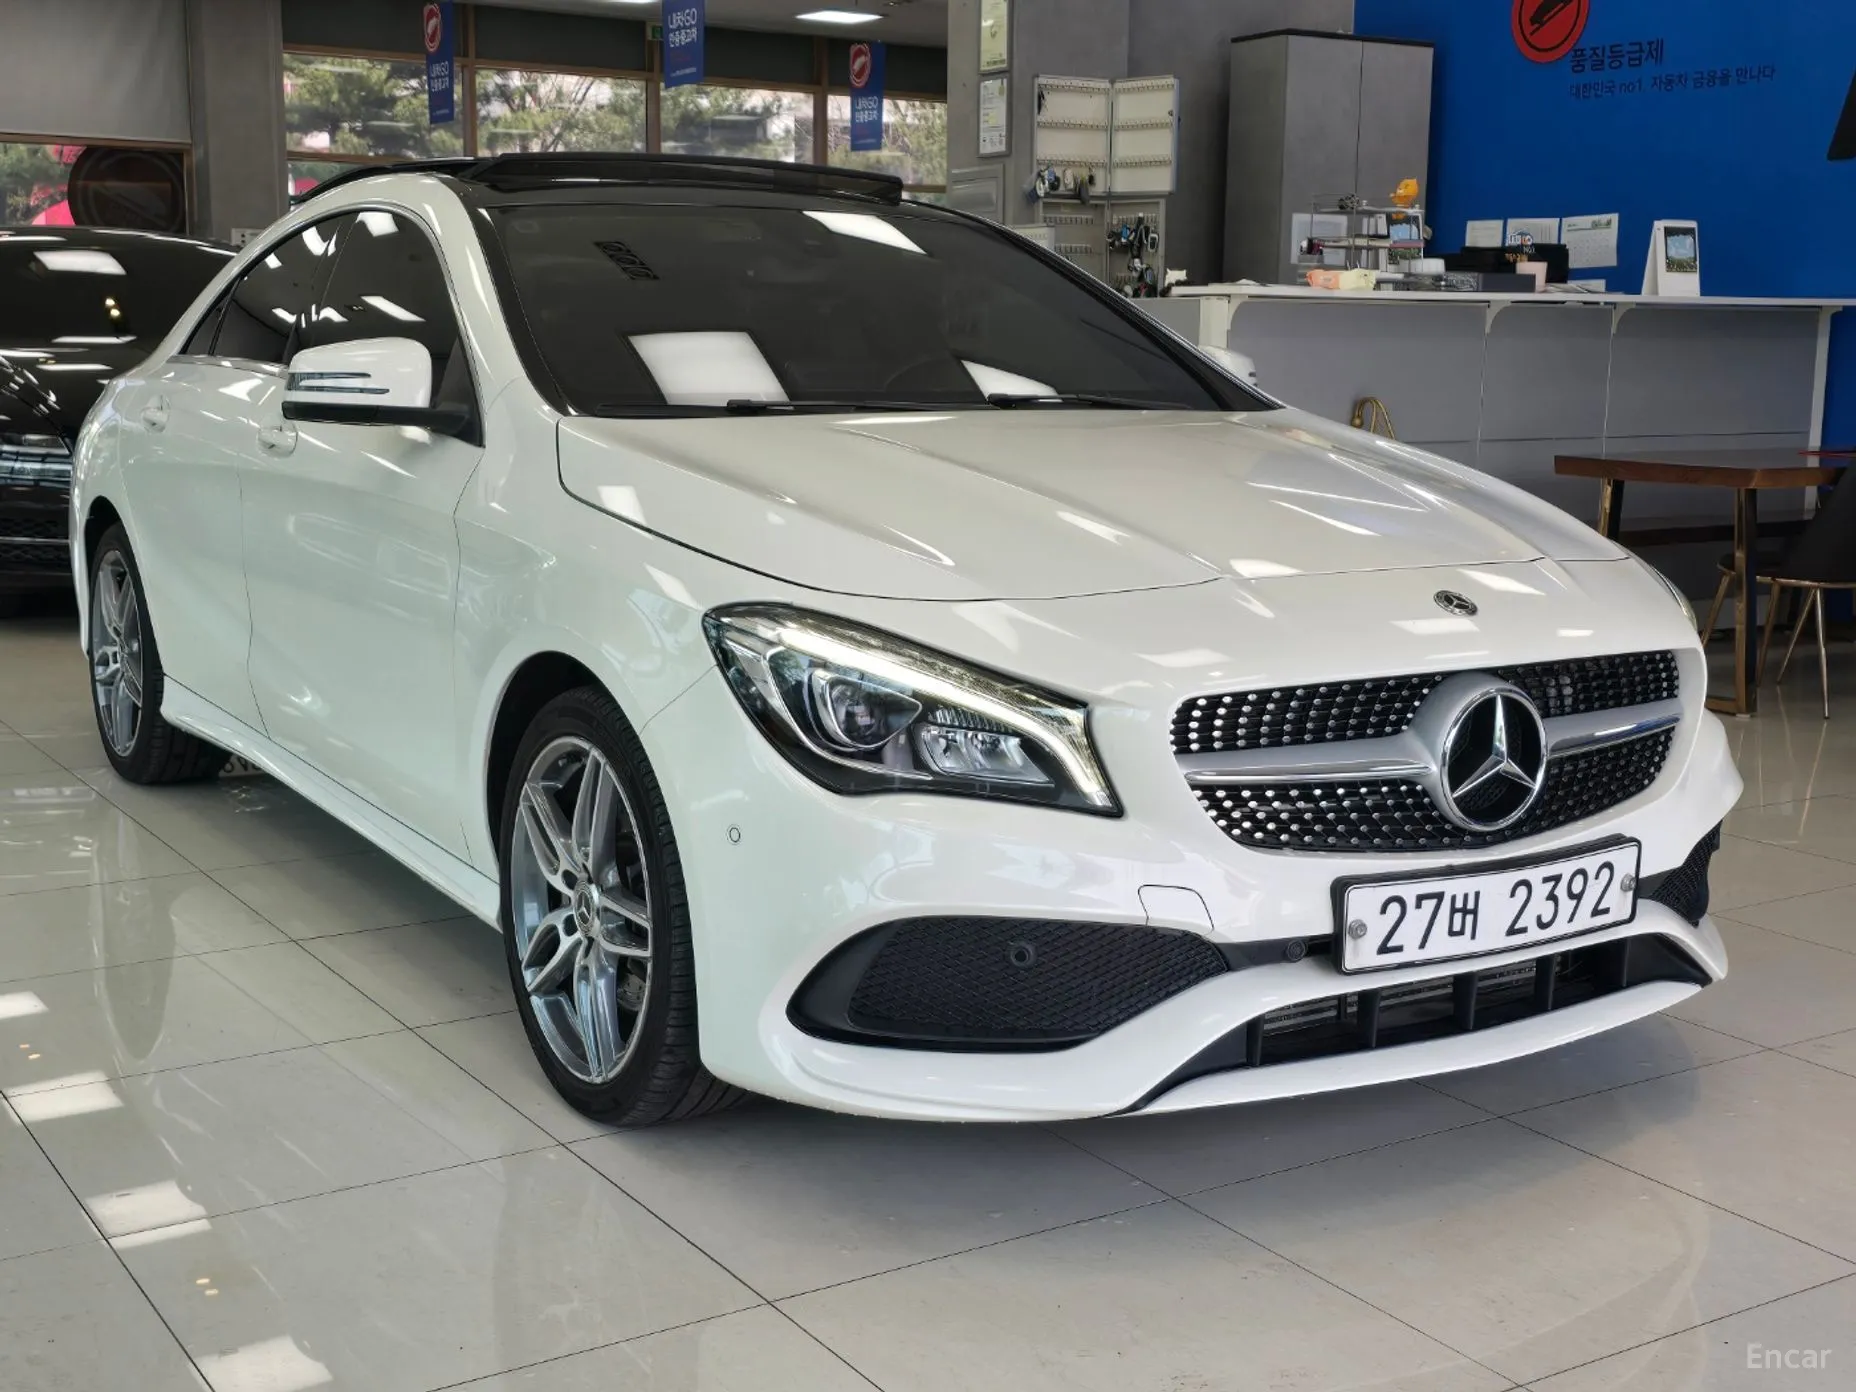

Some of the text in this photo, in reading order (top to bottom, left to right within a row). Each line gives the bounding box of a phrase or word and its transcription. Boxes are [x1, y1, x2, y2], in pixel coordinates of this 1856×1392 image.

[1570, 38, 1664, 73] 품질등급제
[1569, 79, 1615, 99] 대한민국
[1650, 72, 1688, 92] 자동차
[1692, 68, 1732, 89] 금융을
[1735, 63, 1776, 86] 만나다
[1376, 861, 1615, 955] 27버 2392
